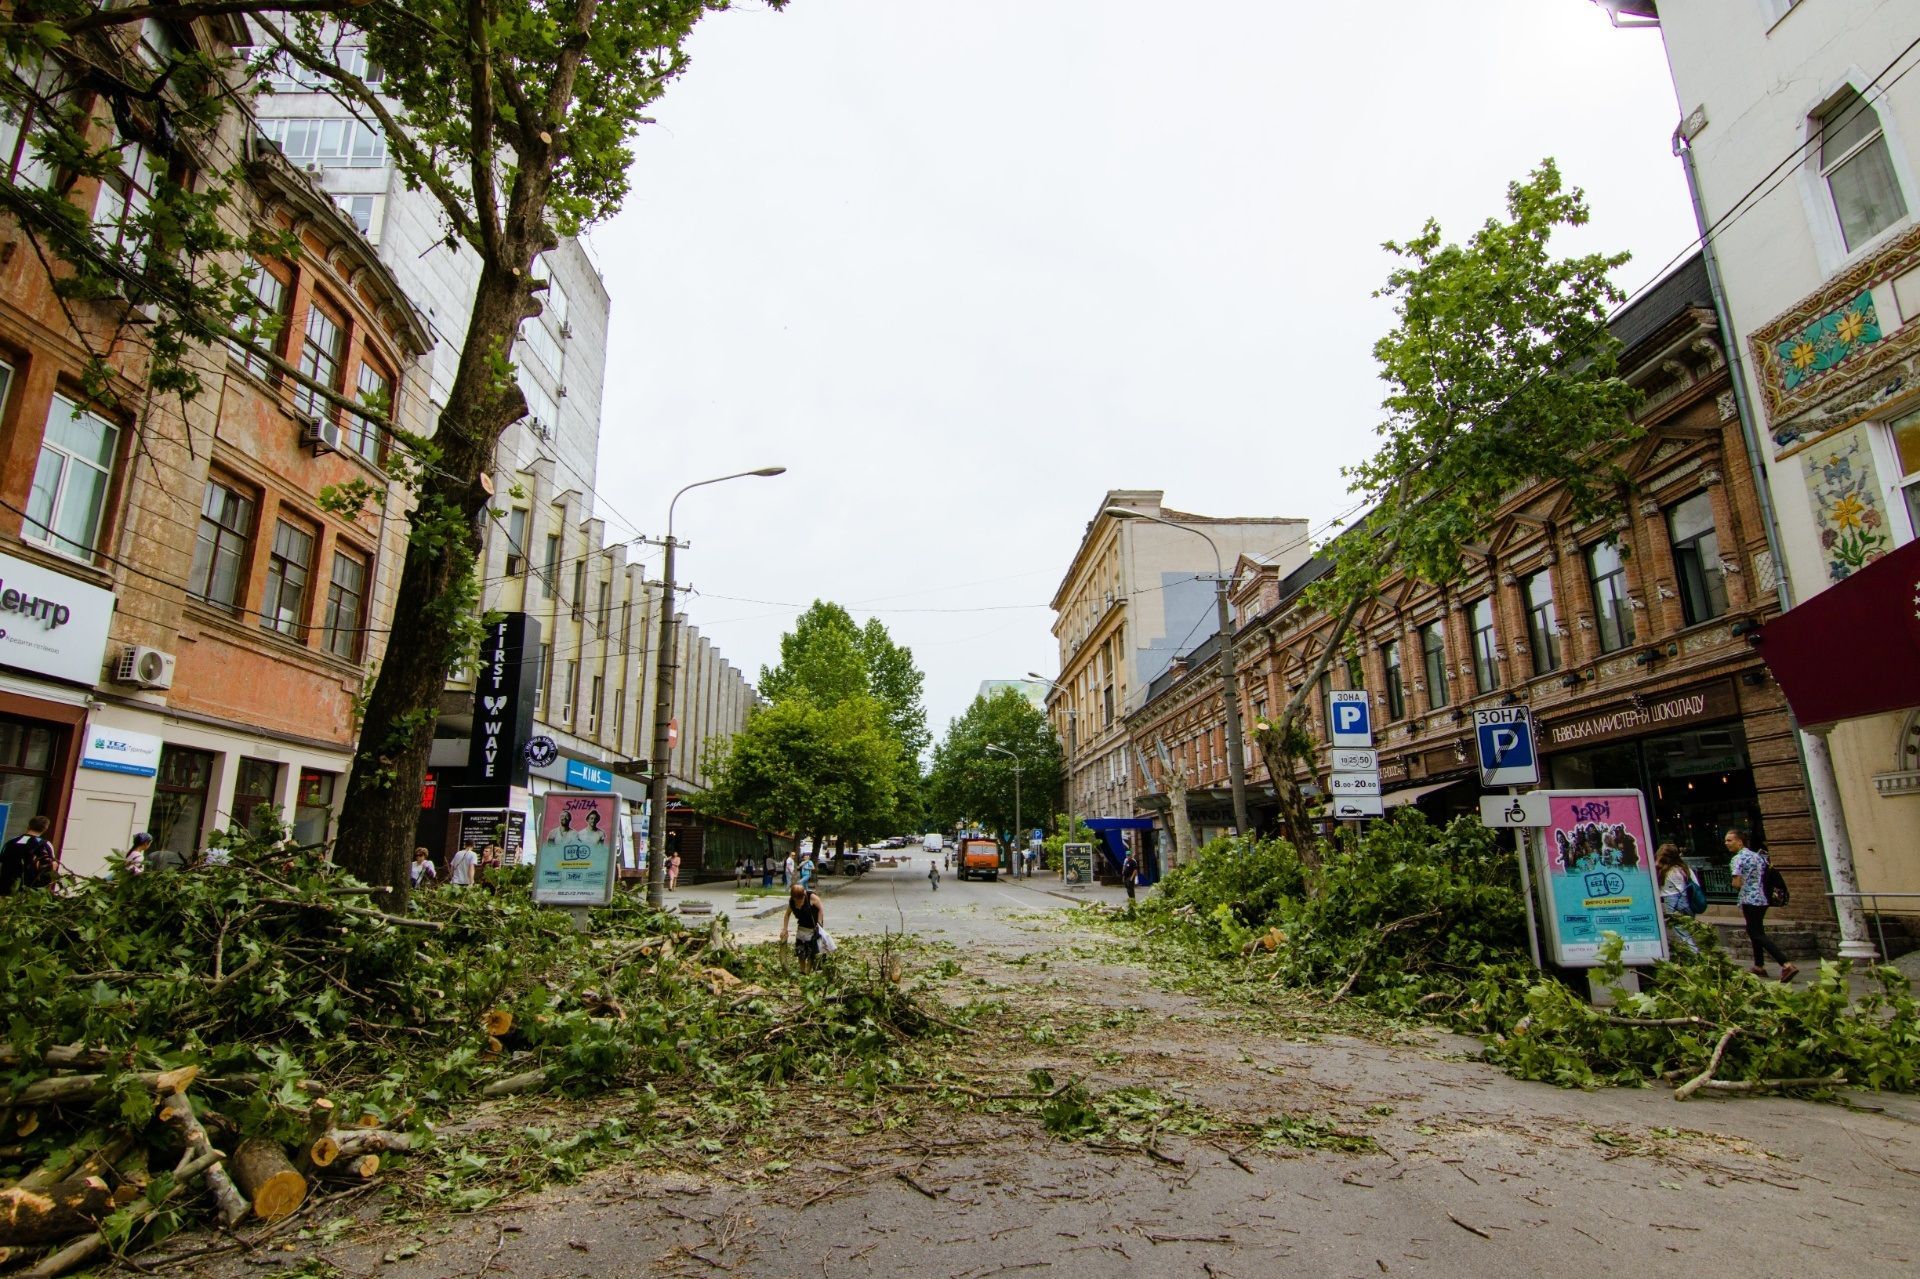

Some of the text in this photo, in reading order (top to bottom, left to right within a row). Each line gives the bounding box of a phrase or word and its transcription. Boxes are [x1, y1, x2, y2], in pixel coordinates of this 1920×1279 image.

[0, 578, 70, 630] ентр
[485, 623, 508, 778] FIRST WAVE
[1337, 693, 1360, 702] ЗОНА
[1650, 694, 1704, 722] ШОКОЛАДУ
[1340, 706, 1361, 730] P
[1477, 708, 1526, 725] ЗОНА
[1348, 756, 1358, 764] 25
[1359, 755, 1369, 764] 50
[582, 765, 601, 784] KIMS
